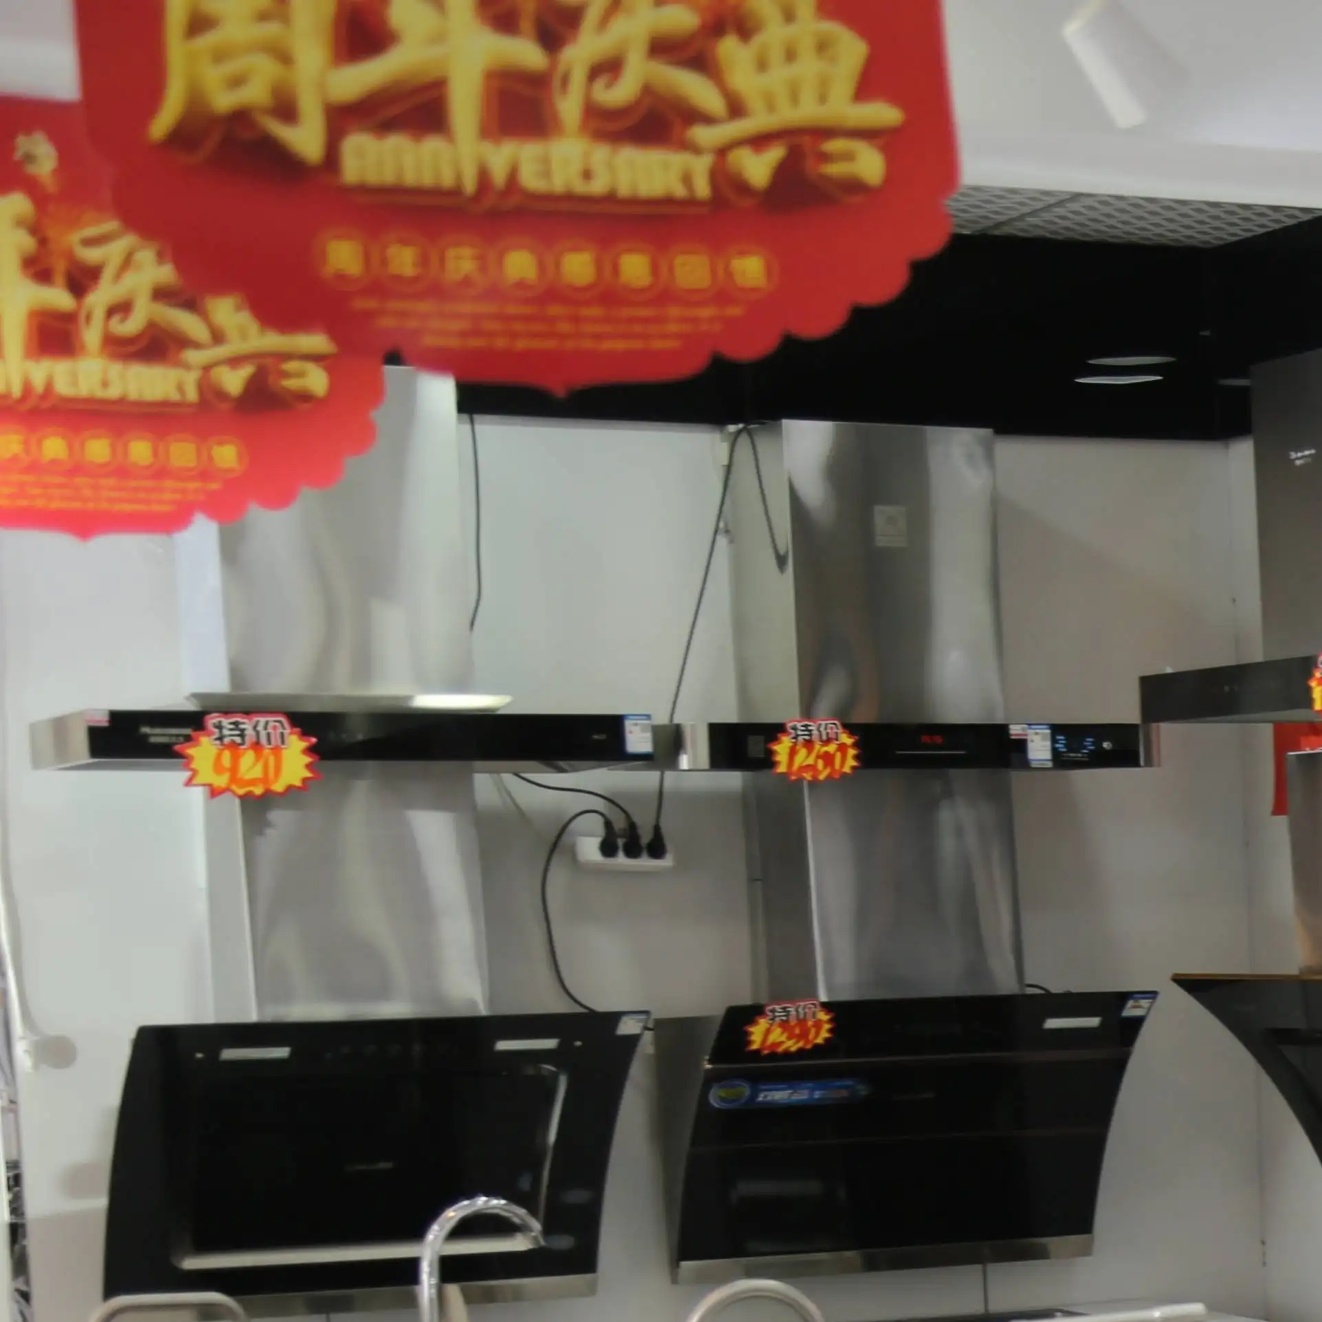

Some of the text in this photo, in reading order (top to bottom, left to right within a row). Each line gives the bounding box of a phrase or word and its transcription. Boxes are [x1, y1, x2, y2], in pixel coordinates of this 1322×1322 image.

[340, 132, 716, 200] ANNVERSARY
[212, 719, 288, 747] 特价
[789, 722, 840, 743] 特价
[765, 1003, 818, 1023] 特价
